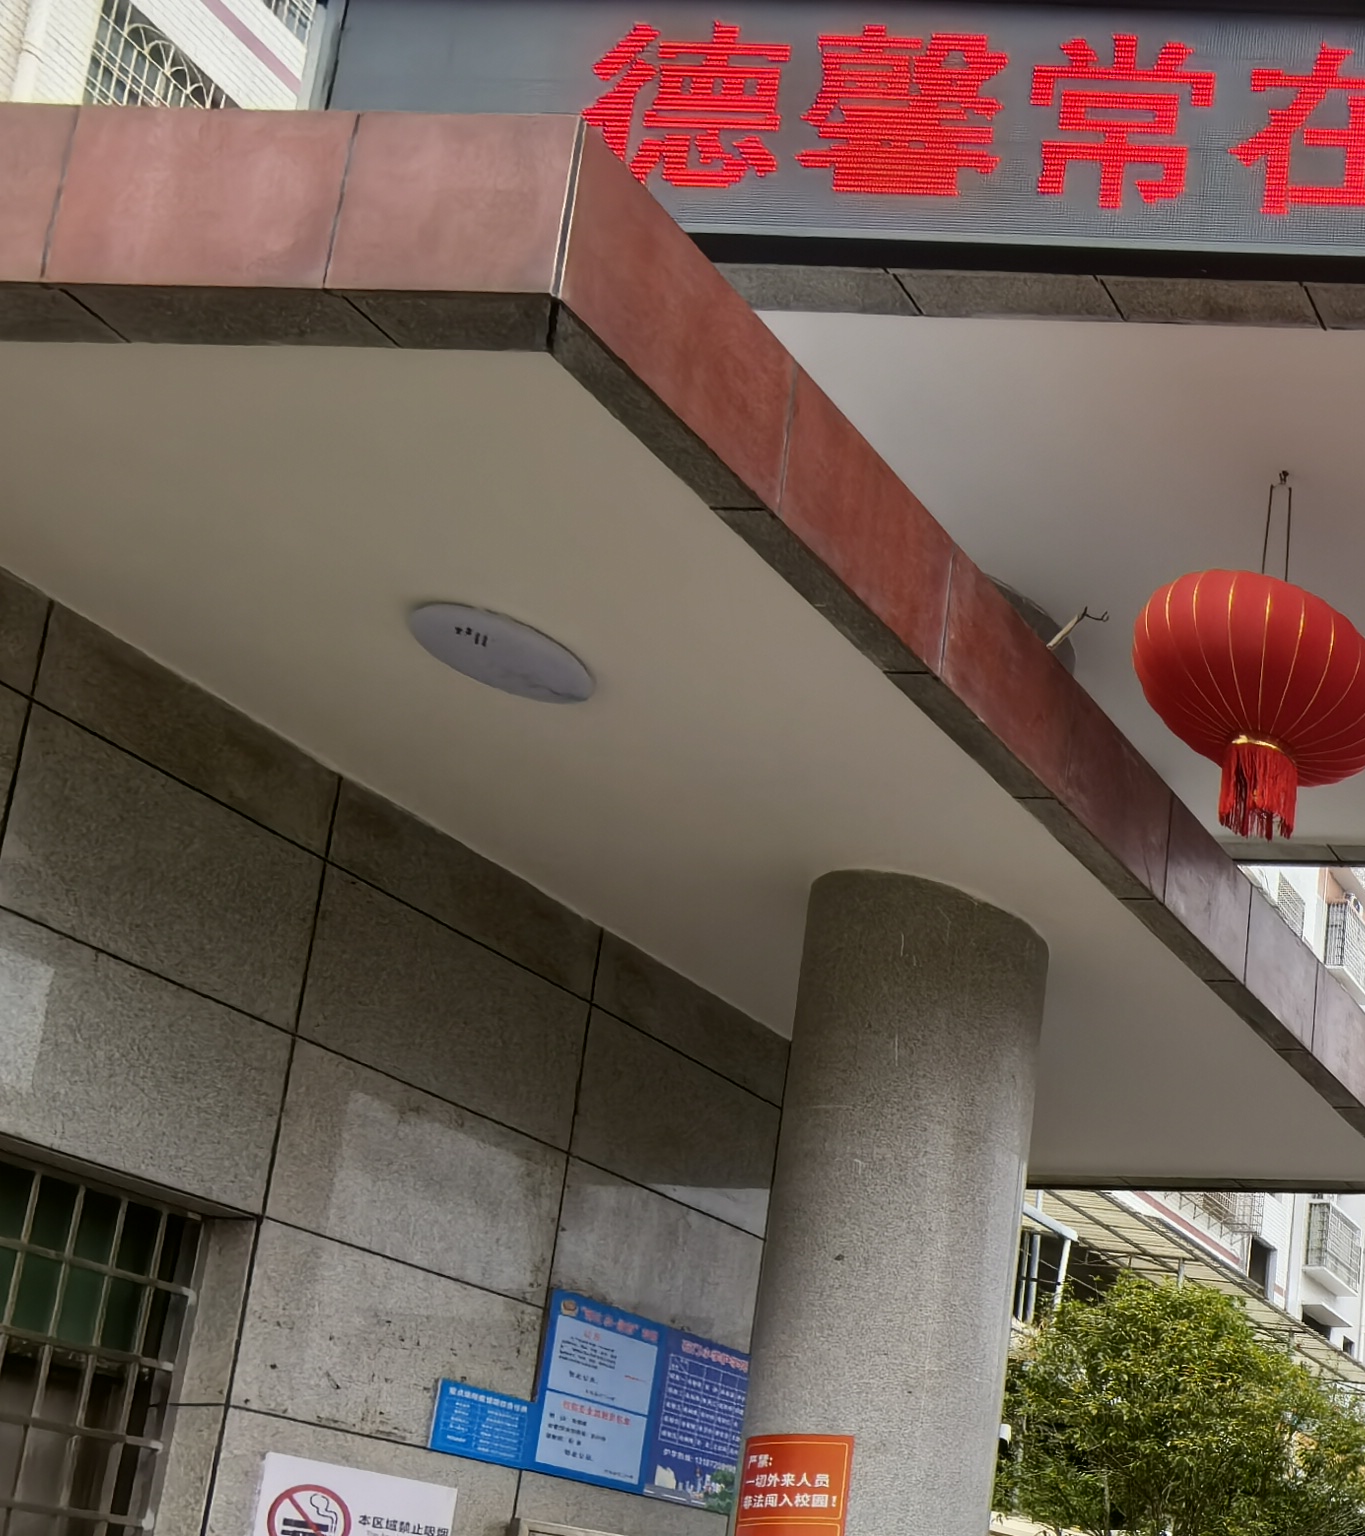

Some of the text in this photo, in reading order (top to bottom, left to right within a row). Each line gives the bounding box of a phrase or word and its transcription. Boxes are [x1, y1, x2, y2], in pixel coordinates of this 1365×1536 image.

[745, 1473, 830, 1488] 一切外来人员
